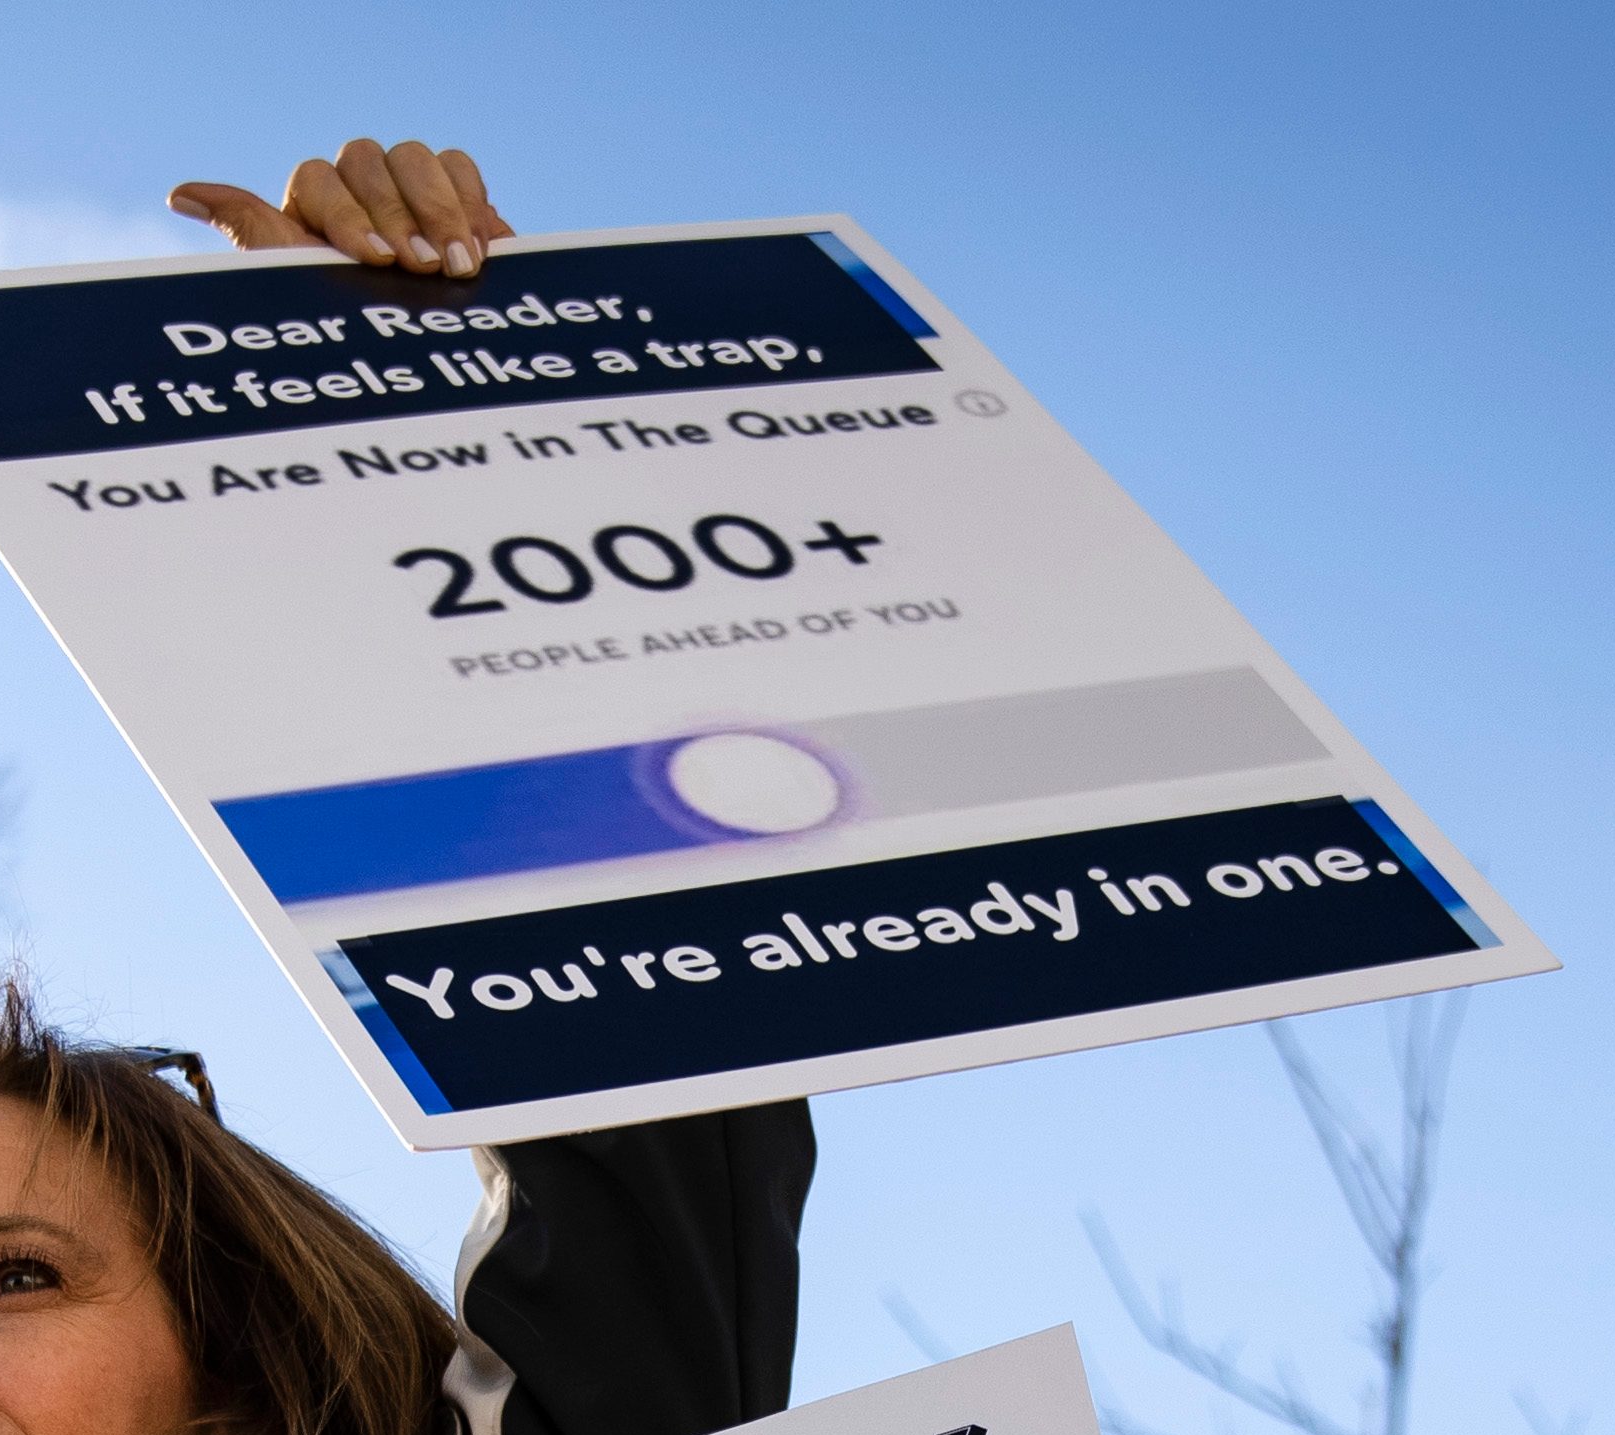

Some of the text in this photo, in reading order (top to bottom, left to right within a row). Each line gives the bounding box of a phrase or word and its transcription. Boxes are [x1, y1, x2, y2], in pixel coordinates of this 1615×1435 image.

[162, 293, 655, 358] Dear Reader,
[84, 382, 148, 425] If
[156, 380, 229, 417] it
[232, 359, 426, 409] feels
[428, 348, 577, 388] like
[591, 348, 640, 374] a
[48, 399, 940, 513] You Are Now in The Queue
[391, 511, 884, 621] 2000+
[449, 597, 964, 679] PEOPLE AHEAD OF YOU
[385, 846, 1400, 1021] You're already in one.
